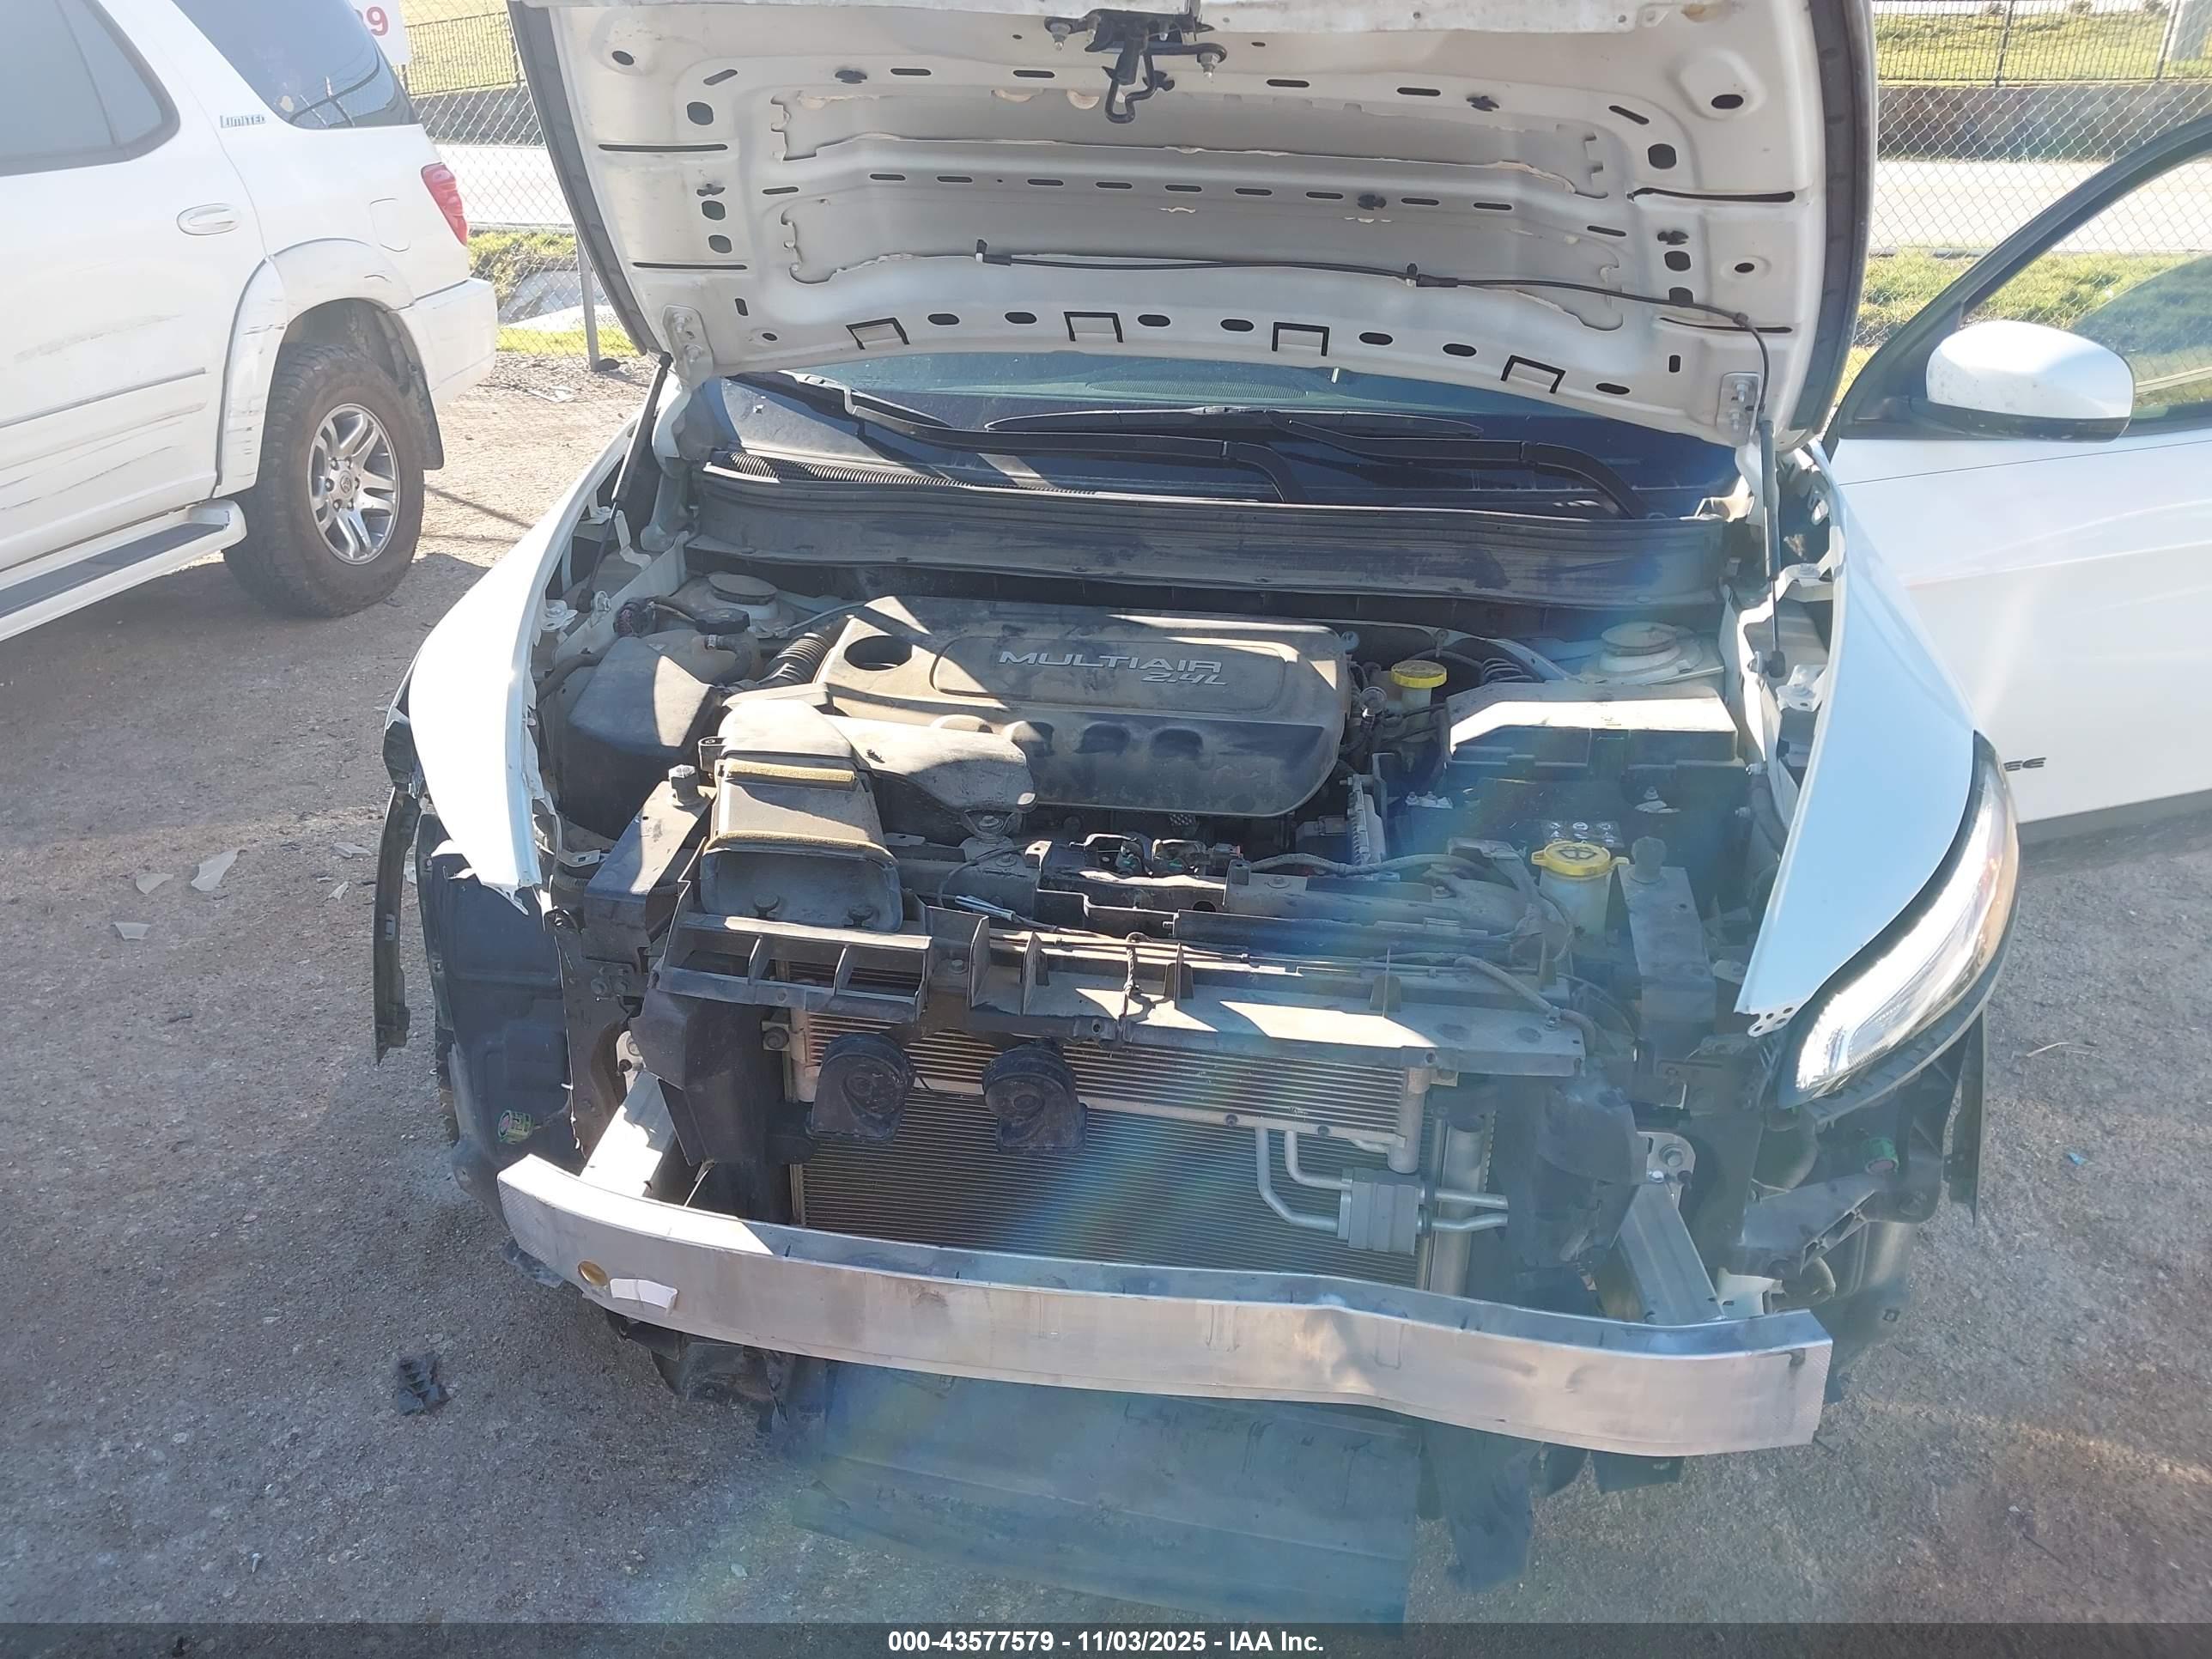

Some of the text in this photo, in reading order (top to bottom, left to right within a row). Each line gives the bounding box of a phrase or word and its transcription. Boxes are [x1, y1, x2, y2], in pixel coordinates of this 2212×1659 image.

[356, 6, 389, 36] 9
[999, 651, 1224, 673] MULTIAIR
[1141, 672, 1228, 686] 2.4L
